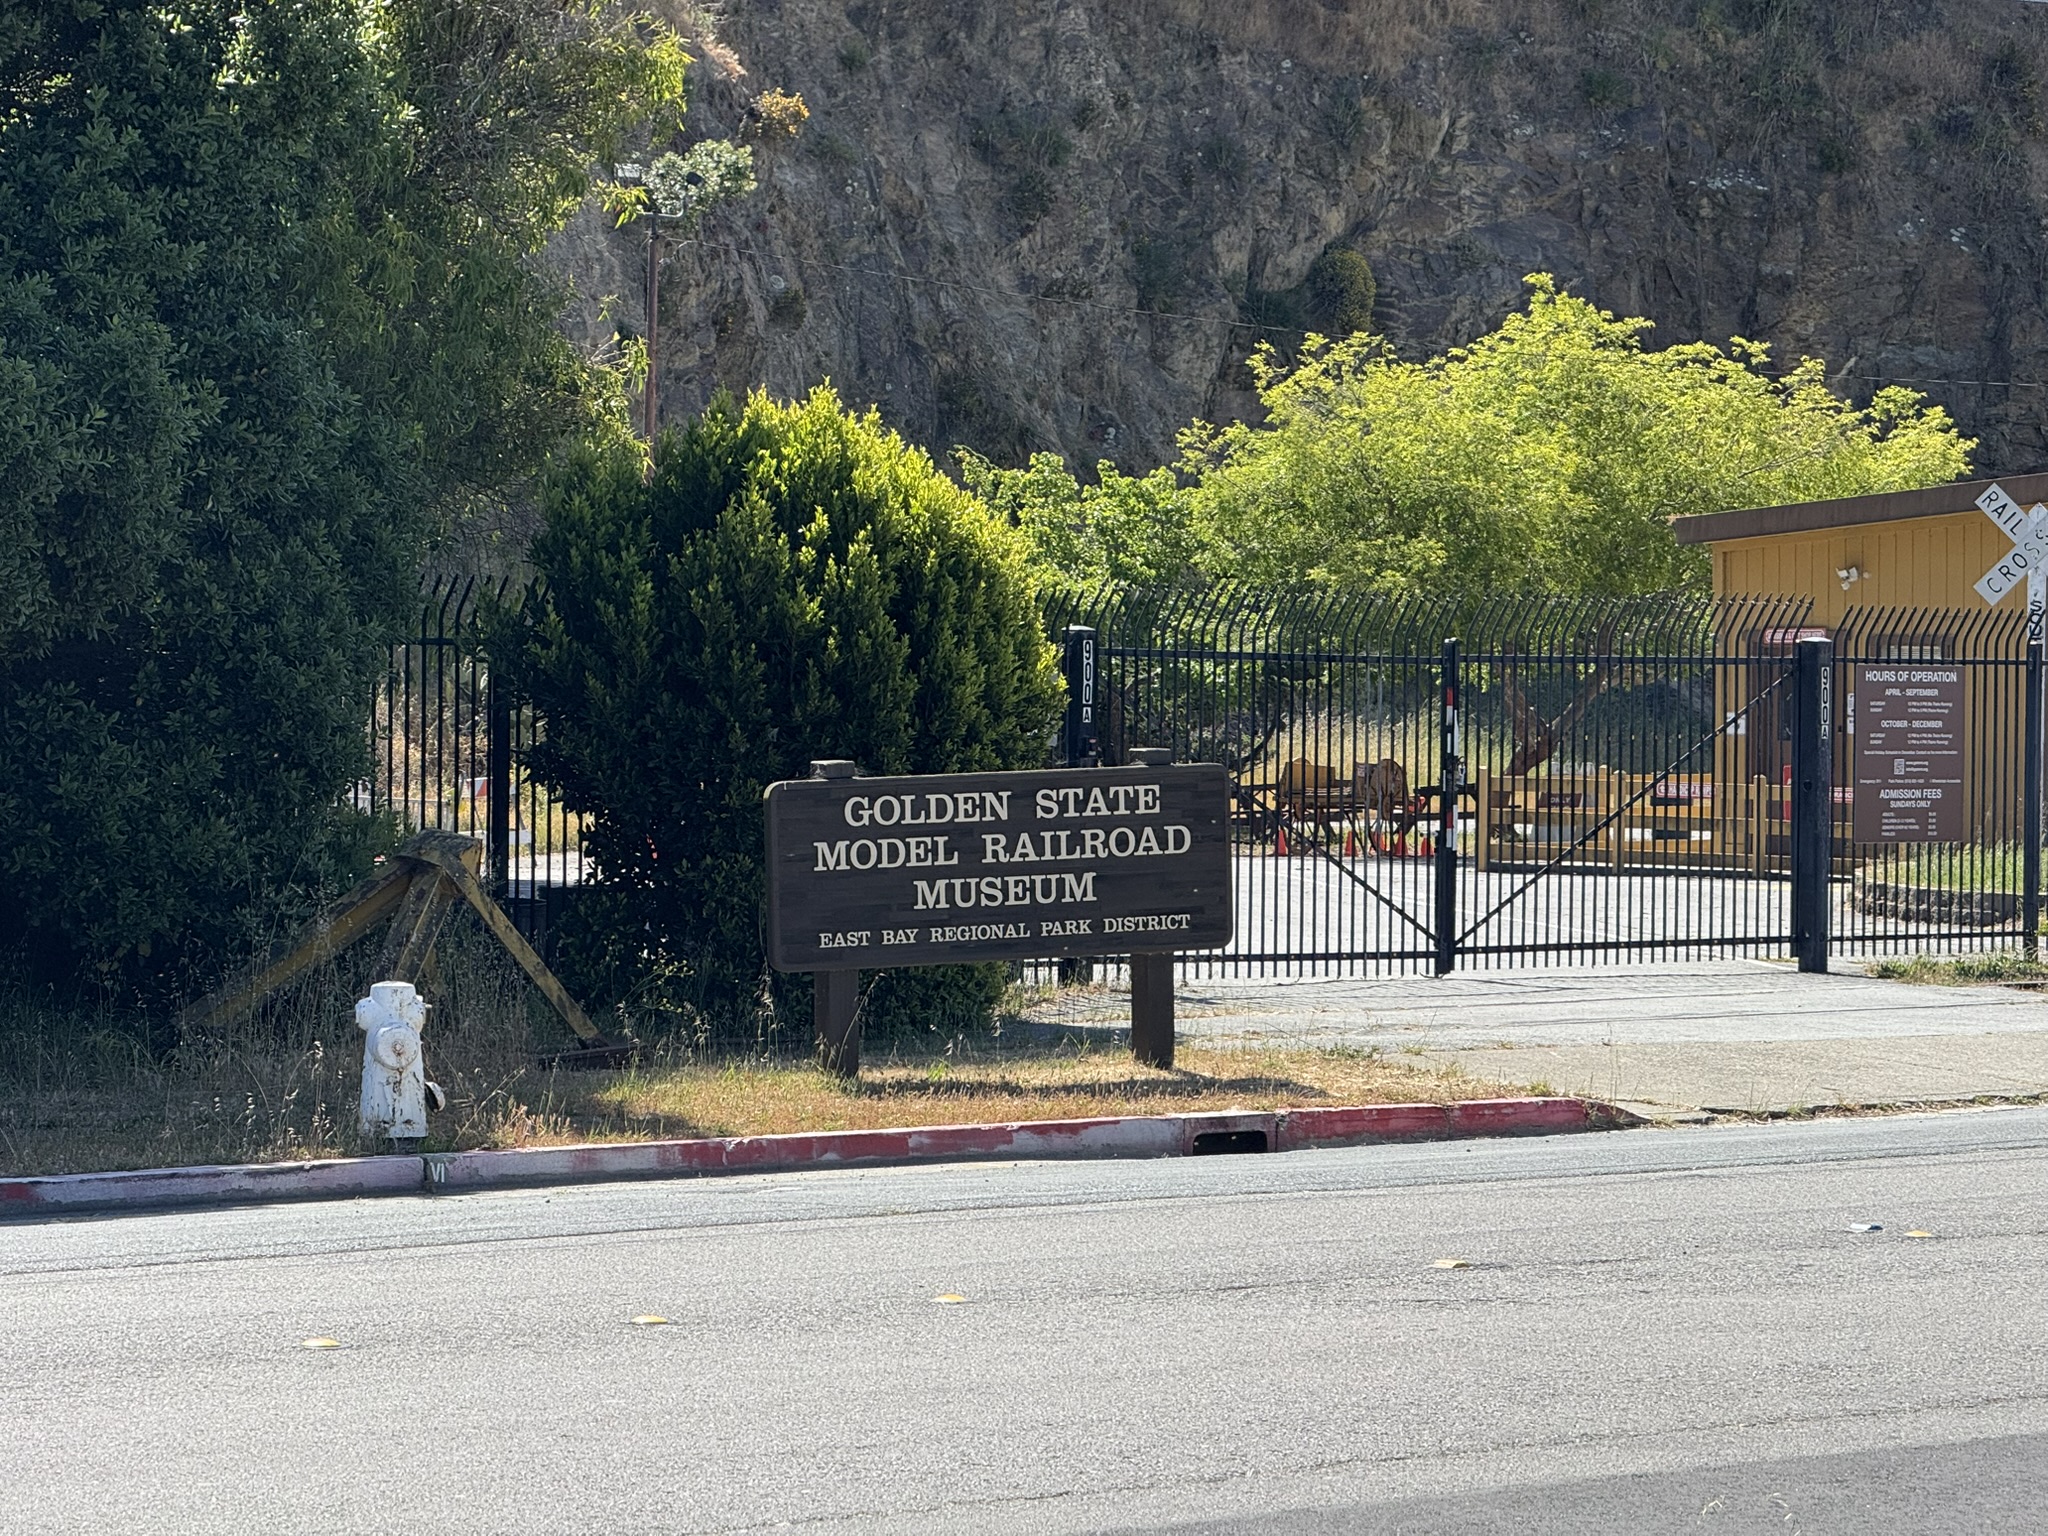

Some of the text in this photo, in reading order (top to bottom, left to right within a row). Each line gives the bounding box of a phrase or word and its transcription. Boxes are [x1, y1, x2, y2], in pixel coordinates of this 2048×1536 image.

[1981, 490, 2023, 536] RAIL
[1865, 671, 1957, 683] HOURS OF OPERATION
[1881, 720, 1908, 728] OCTOBER
[844, 784, 1161, 827] GOLDEN STATE
[1880, 789, 1942, 799] ADMISSION FEES
[813, 825, 1192, 871] MODEL RAILROAD
[913, 872, 1097, 910] MUSEUM
[819, 914, 1191, 948] EAST BAY REGIONAL PARK DISTRICT
